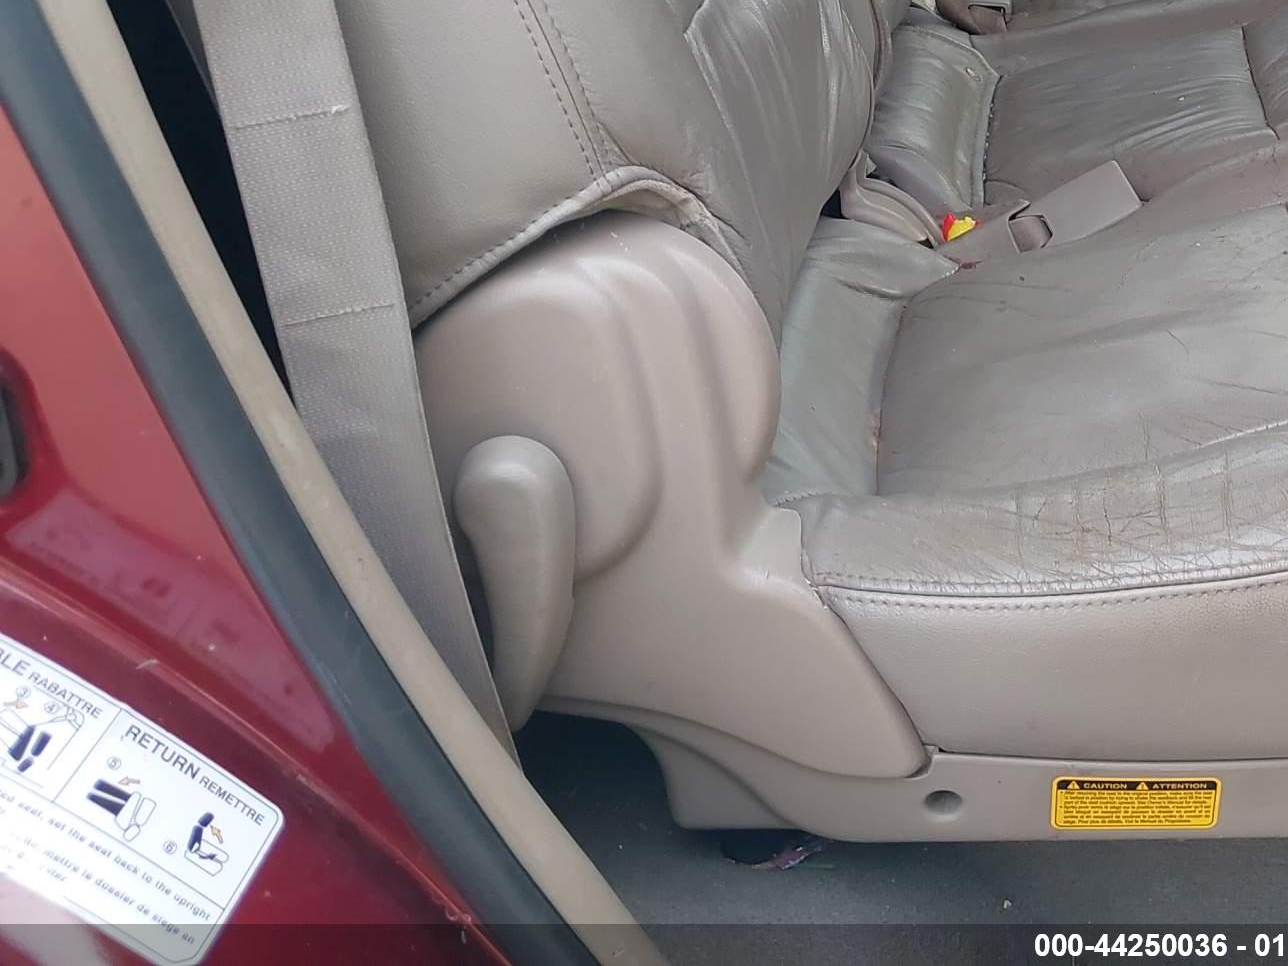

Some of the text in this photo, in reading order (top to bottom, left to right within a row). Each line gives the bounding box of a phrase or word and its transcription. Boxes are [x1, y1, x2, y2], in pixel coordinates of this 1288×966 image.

[28, 671, 103, 720] RABATTRE
[125, 724, 266, 827] RETURN REMETTRE
[173, 894, 211, 921] upright
